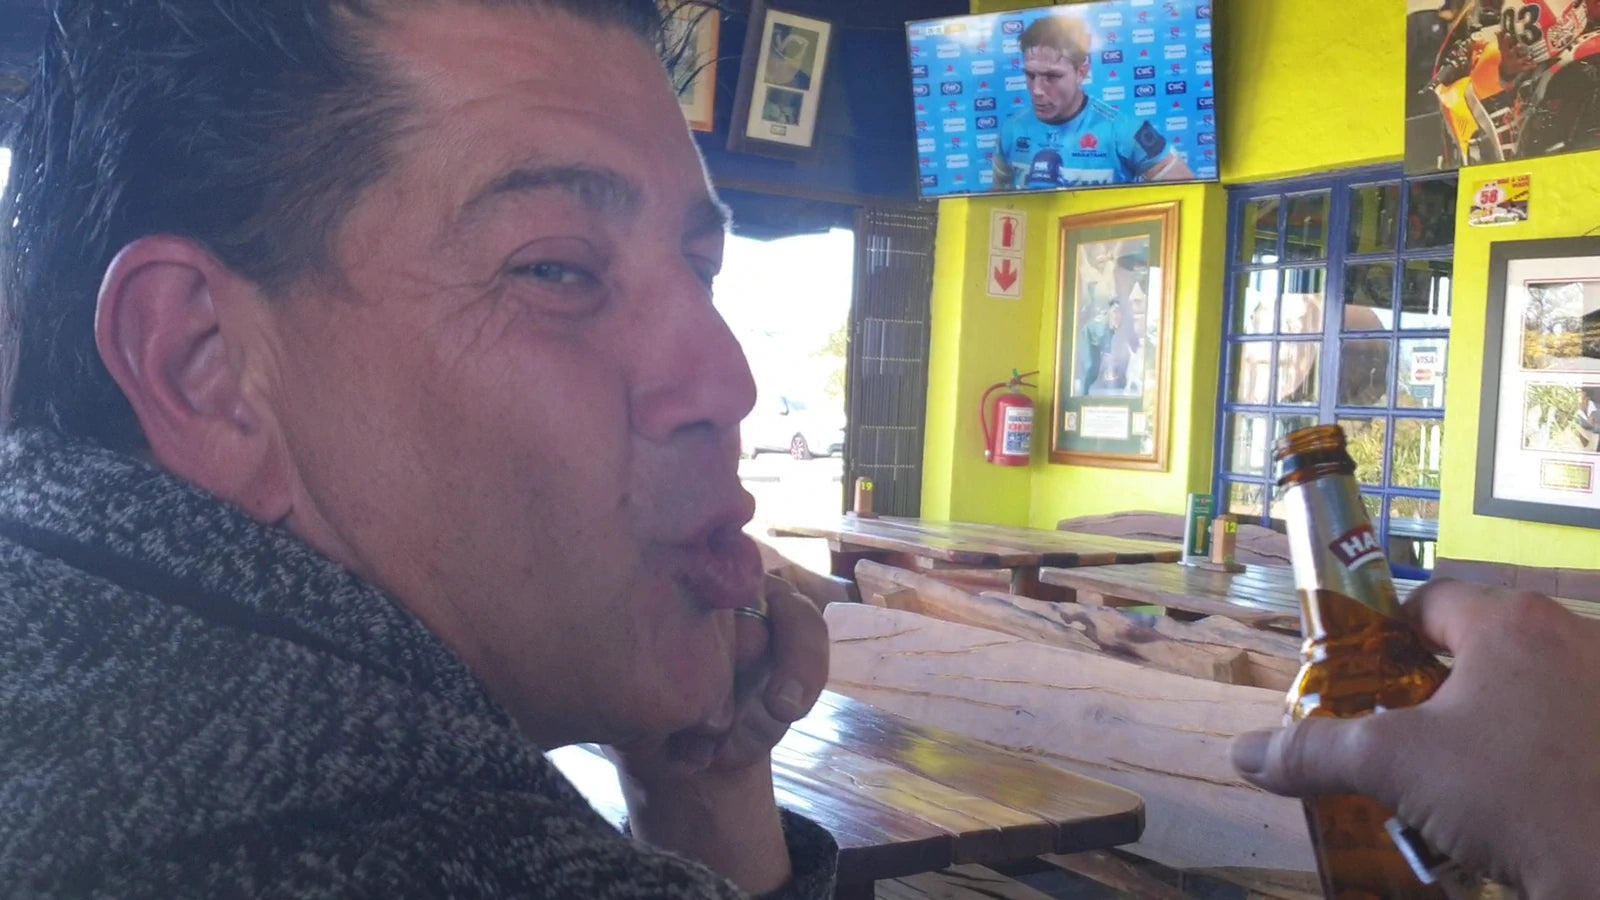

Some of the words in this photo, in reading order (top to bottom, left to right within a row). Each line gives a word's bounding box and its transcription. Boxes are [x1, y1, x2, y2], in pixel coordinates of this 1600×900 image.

[1480, 189, 1498, 205] 58
[861, 481, 873, 491] 19
[1225, 521, 1238, 533] 12
